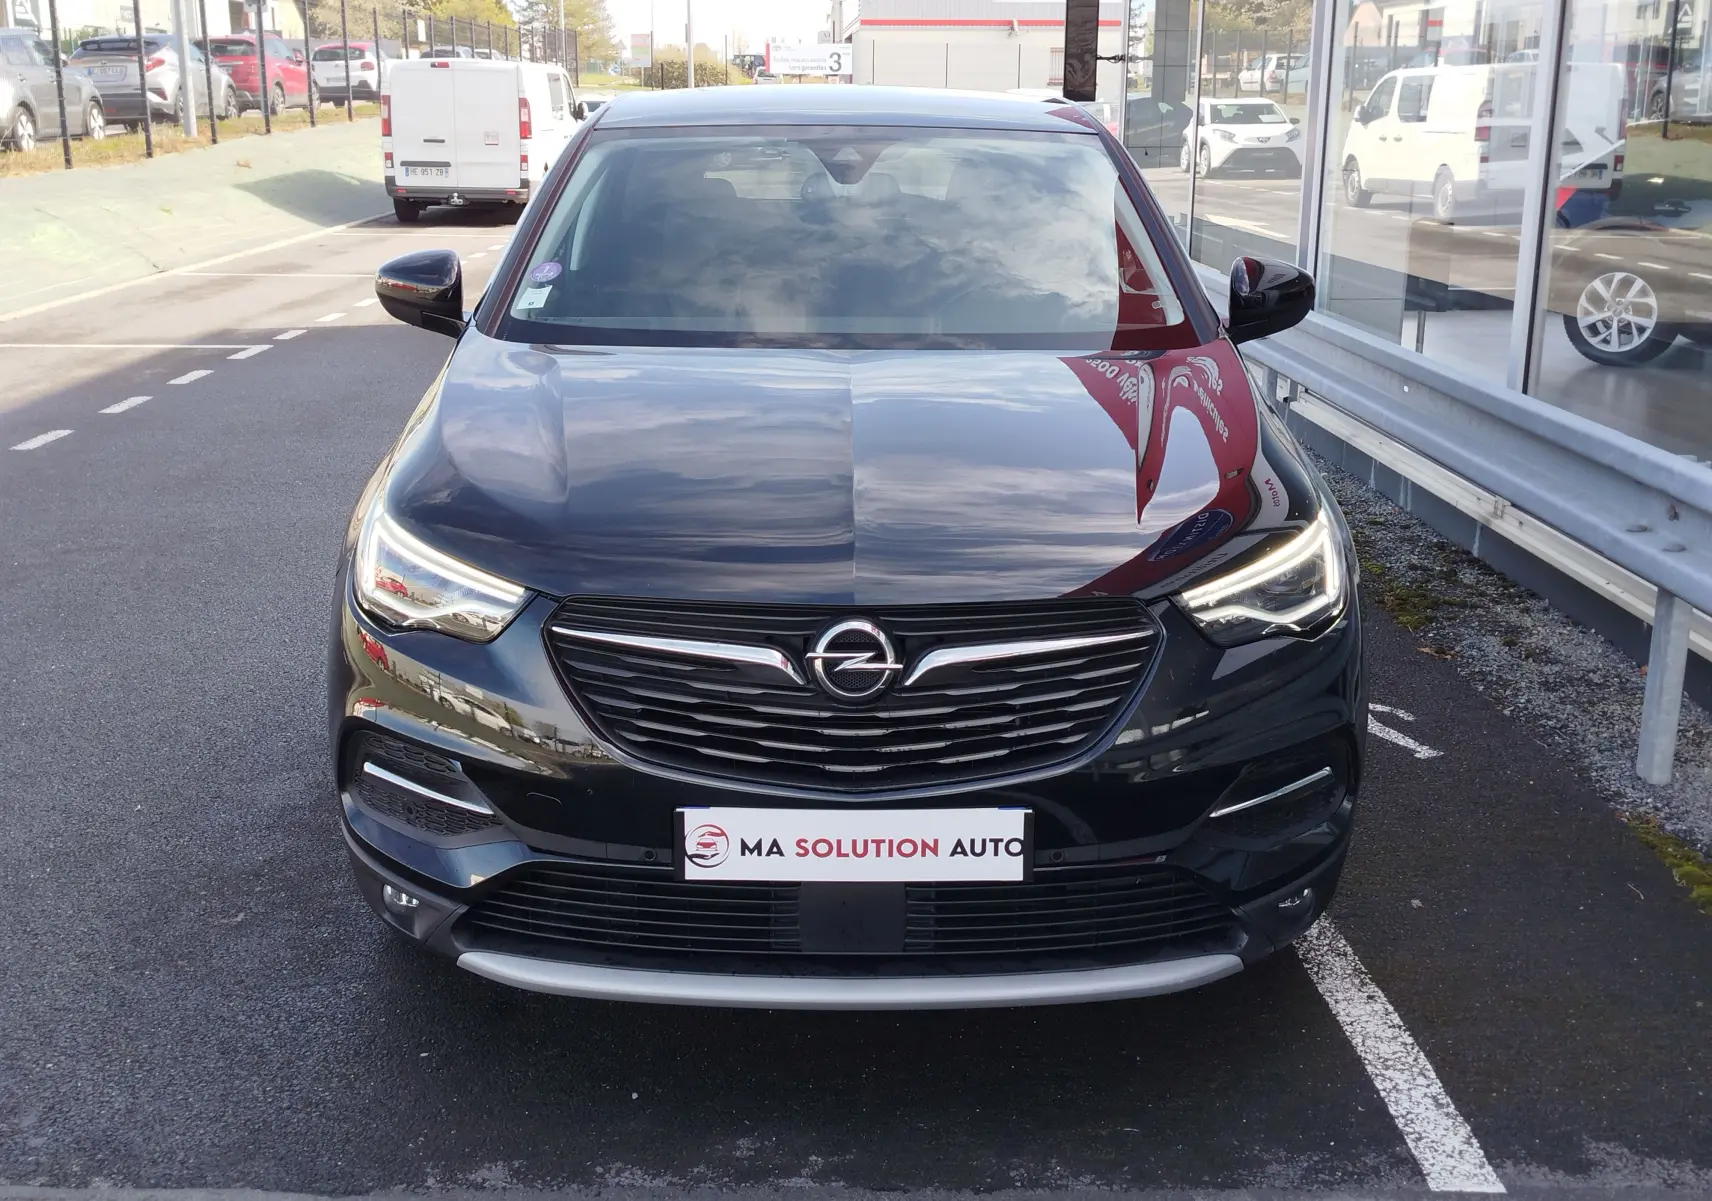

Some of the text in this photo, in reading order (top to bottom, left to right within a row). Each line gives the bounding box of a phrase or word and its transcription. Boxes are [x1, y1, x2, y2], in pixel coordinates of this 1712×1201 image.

[829, 52, 842, 73] 3
[740, 837, 1024, 859] MA SOLUTION AUTO
